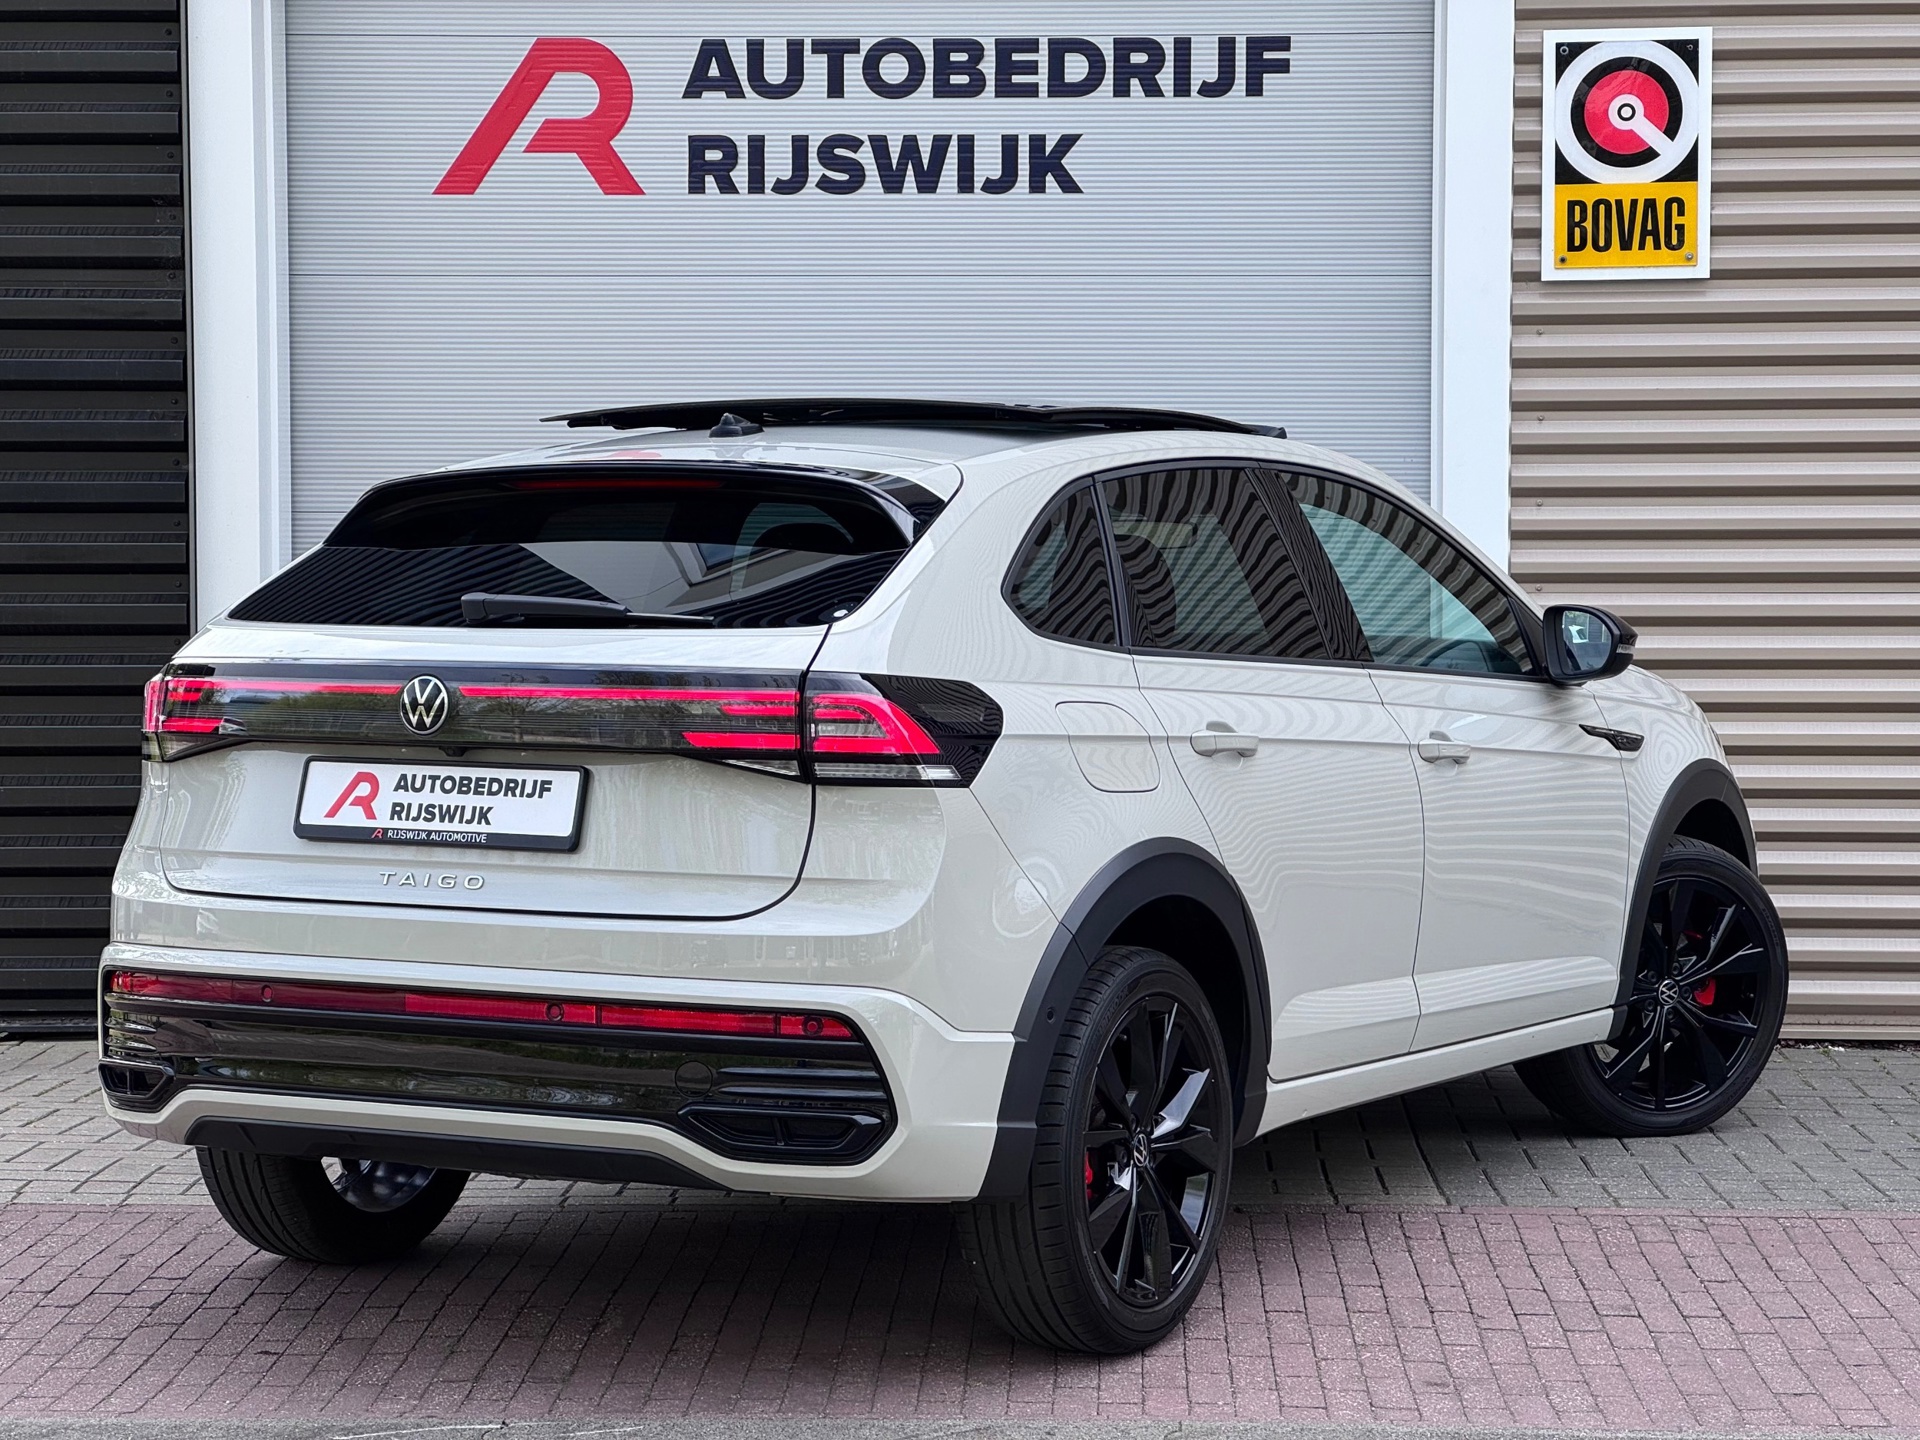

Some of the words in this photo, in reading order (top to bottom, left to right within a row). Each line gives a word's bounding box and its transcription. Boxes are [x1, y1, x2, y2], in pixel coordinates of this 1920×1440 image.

[681, 36, 1292, 99] AUTOBEDRIJF
[687, 133, 1085, 195] RIJSWIJK
[1566, 196, 1686, 253] BOVAG
[393, 773, 553, 799] AUTOBEDRIJF
[389, 802, 494, 826] RIJSWIJK
[387, 829, 428, 840] RIJSWIJK
[429, 831, 488, 843] AUTOMOTIVE
[379, 871, 486, 890] TAIGO
